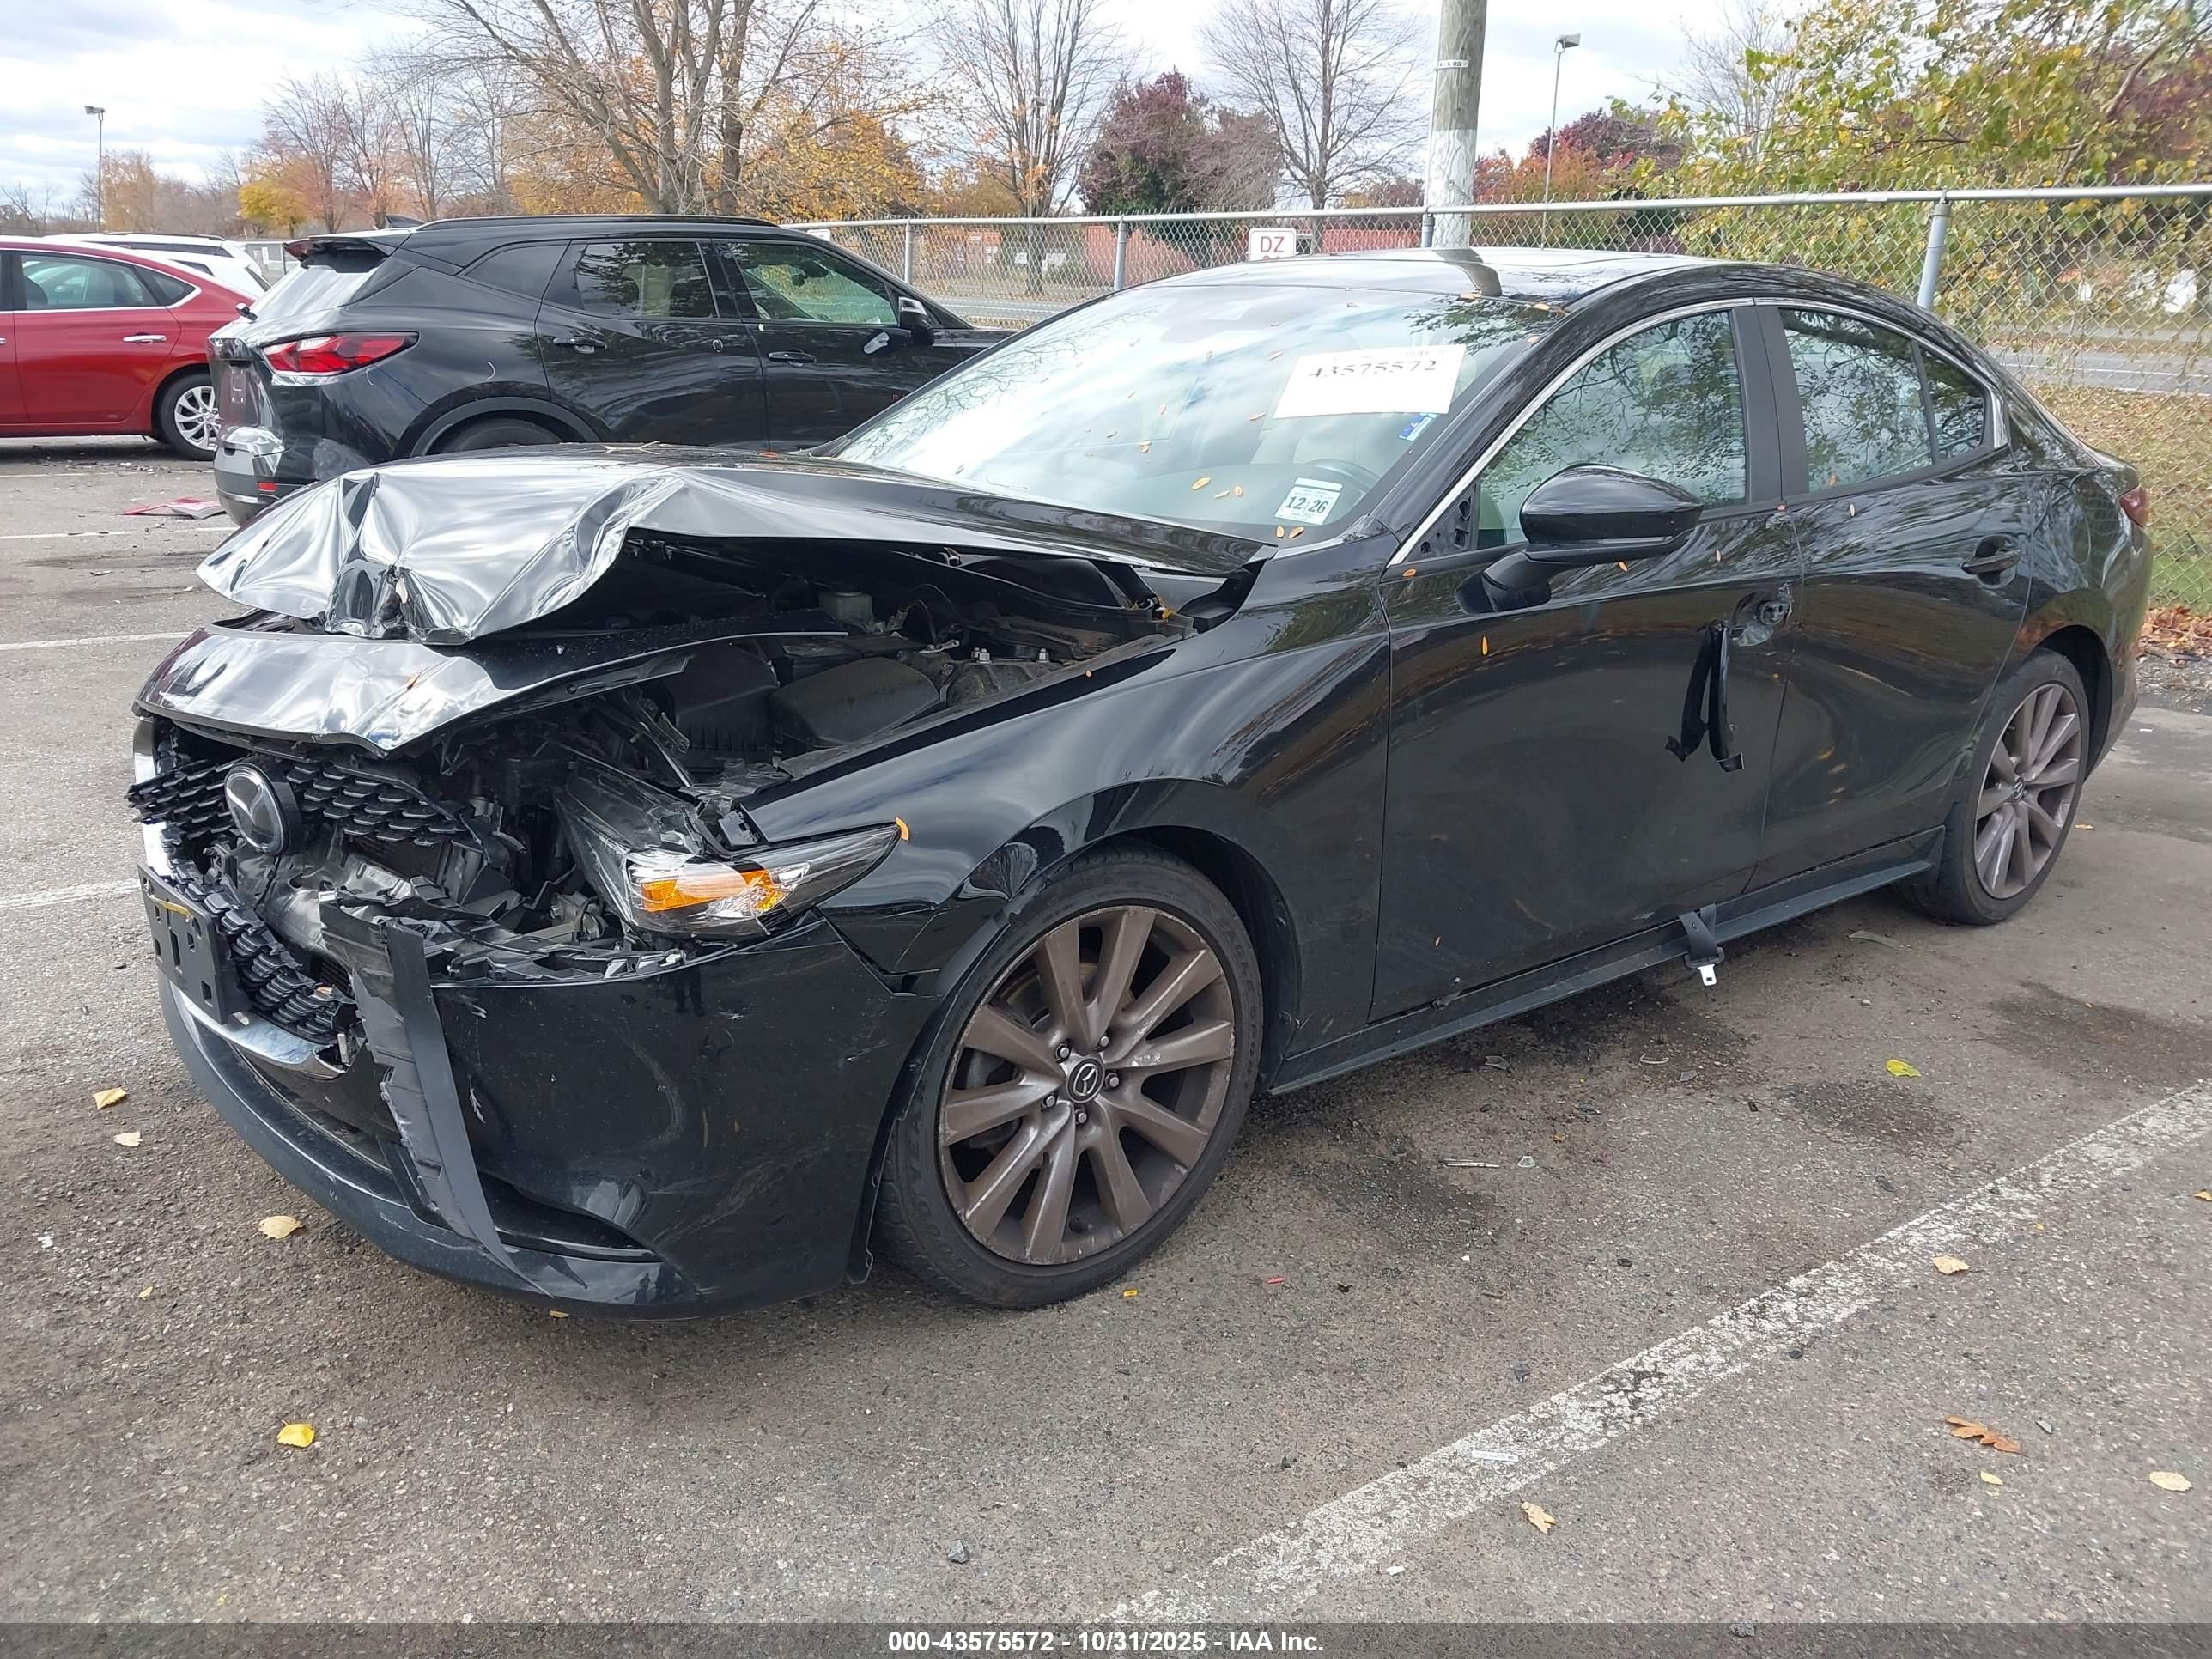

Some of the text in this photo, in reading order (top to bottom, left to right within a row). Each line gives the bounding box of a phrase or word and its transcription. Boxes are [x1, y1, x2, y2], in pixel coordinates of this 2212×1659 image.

[1260, 235, 1285, 252] DZ
[1308, 359, 1438, 378] 43575572
[1285, 495, 1329, 514] 12 26
